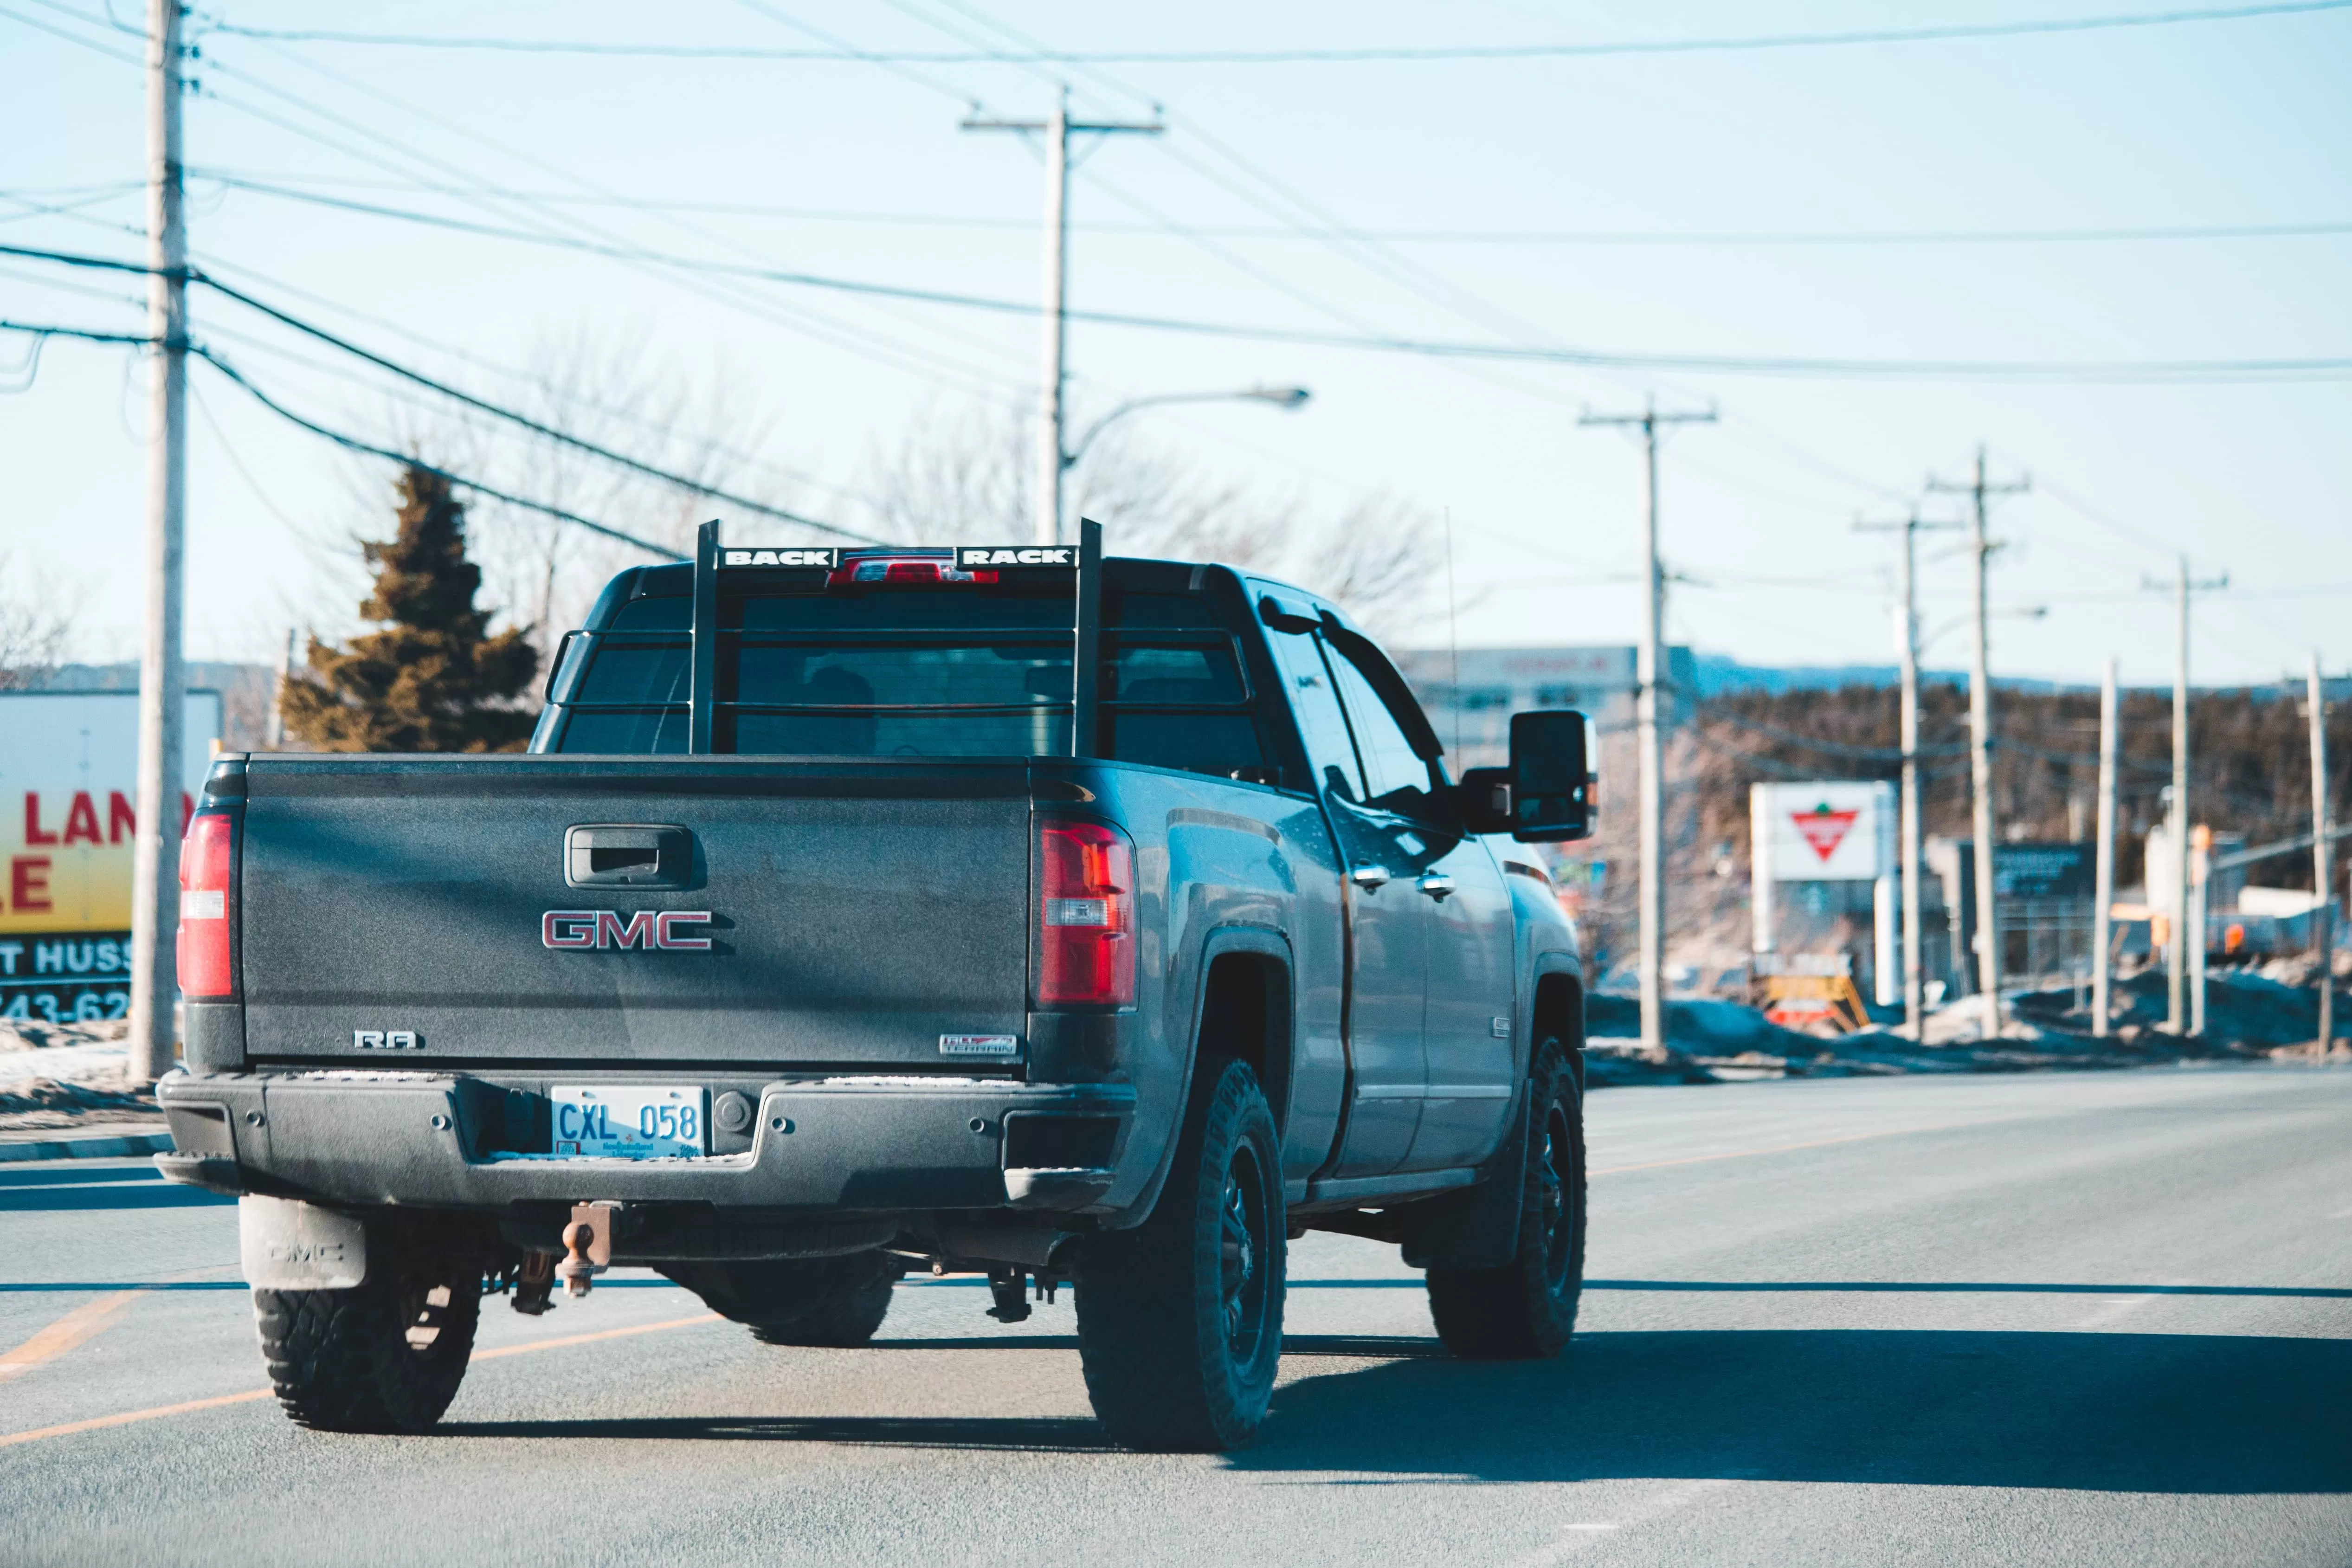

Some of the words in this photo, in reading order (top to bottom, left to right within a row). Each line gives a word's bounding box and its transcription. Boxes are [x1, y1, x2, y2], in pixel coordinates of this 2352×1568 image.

[725, 551, 830, 565] BACK
[963, 549, 1069, 564] RACK
[542, 910, 712, 950] GMC
[560, 1104, 618, 1139] CXL
[640, 1105, 696, 1139] 058
[271, 1243, 344, 1263] GMC
